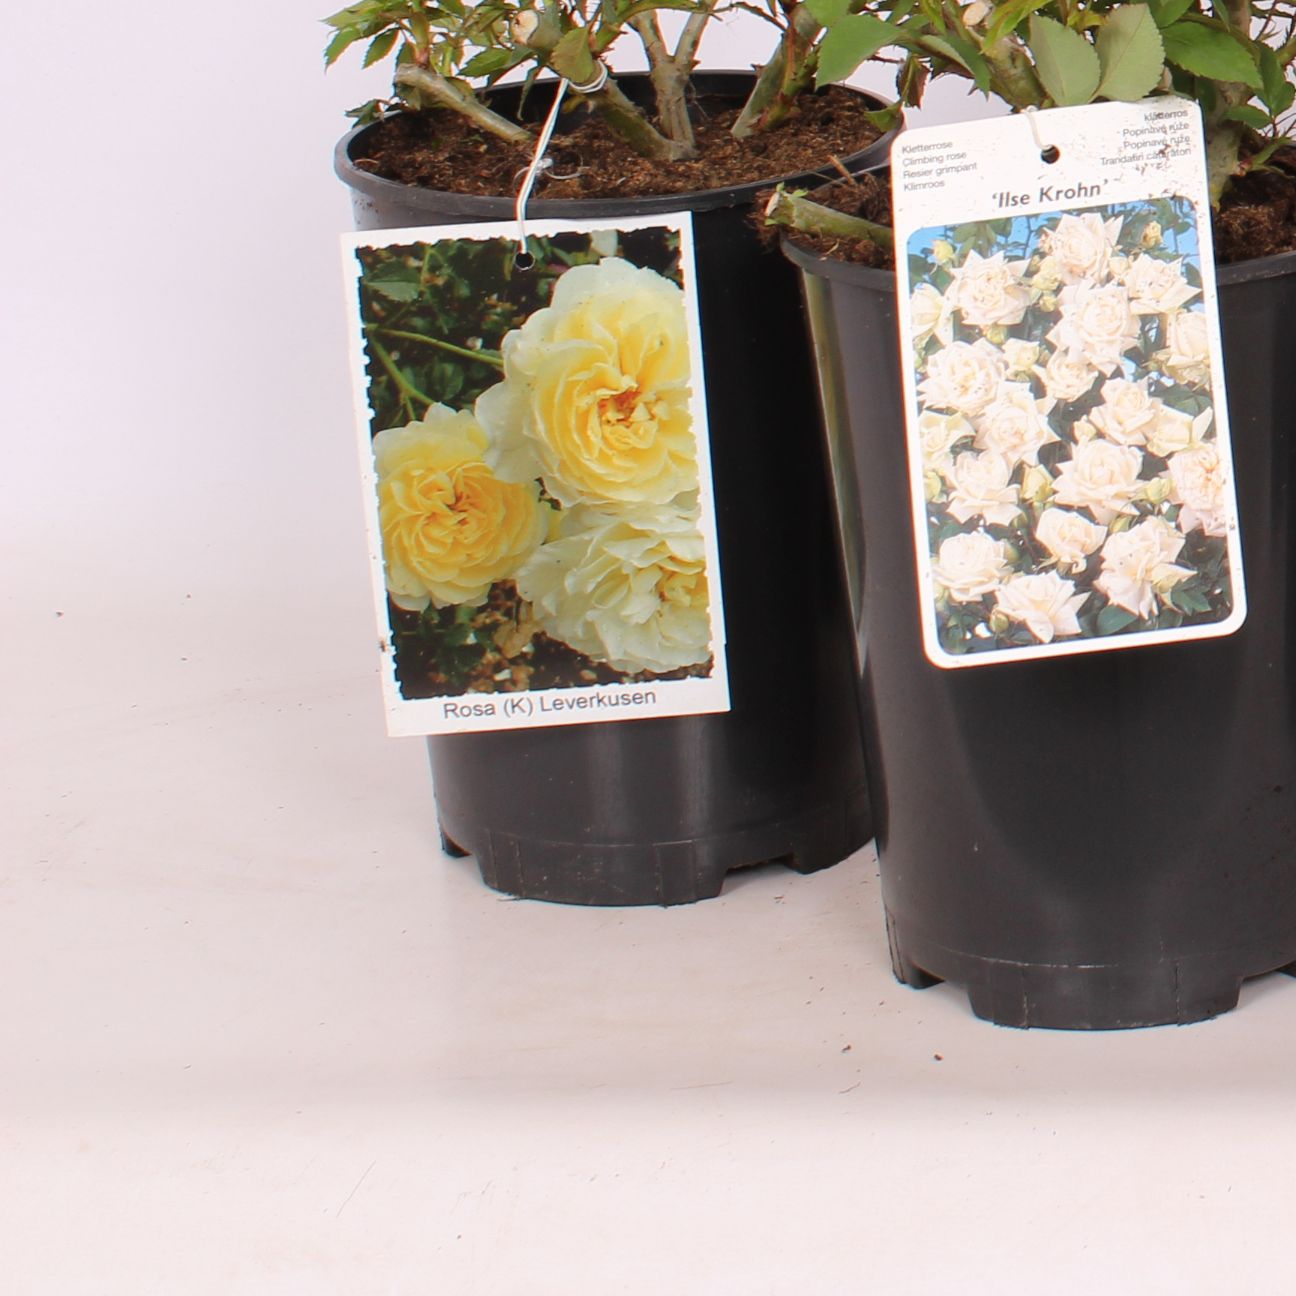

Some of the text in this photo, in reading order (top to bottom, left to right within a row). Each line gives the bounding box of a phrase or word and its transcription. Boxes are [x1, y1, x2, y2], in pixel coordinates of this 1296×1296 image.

[902, 152, 967, 167] Climbing rose
[935, 162, 977, 176] grimpant
[443, 689, 657, 719] Rosa (K) Leverkusen
